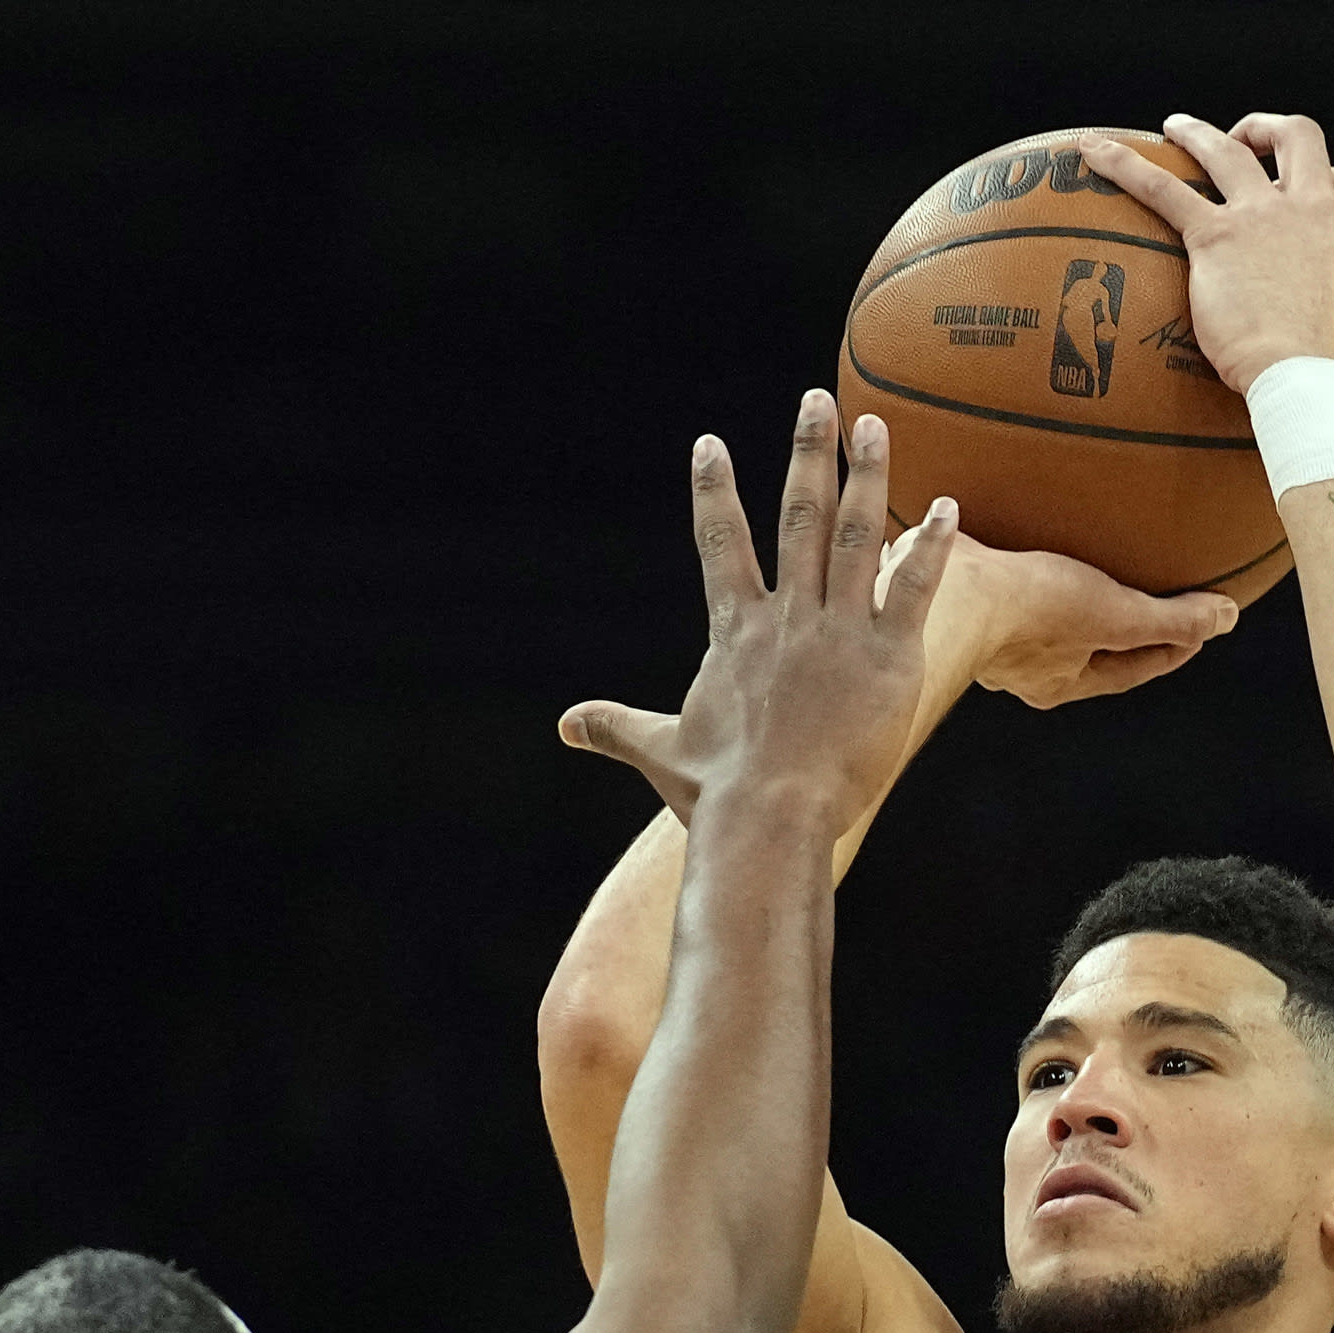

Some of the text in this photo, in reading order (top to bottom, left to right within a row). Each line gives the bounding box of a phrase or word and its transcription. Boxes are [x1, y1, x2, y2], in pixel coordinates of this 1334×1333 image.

[933, 305, 1040, 329] OFFICIAL GAME BALL
[1057, 364, 1087, 392] NBA
